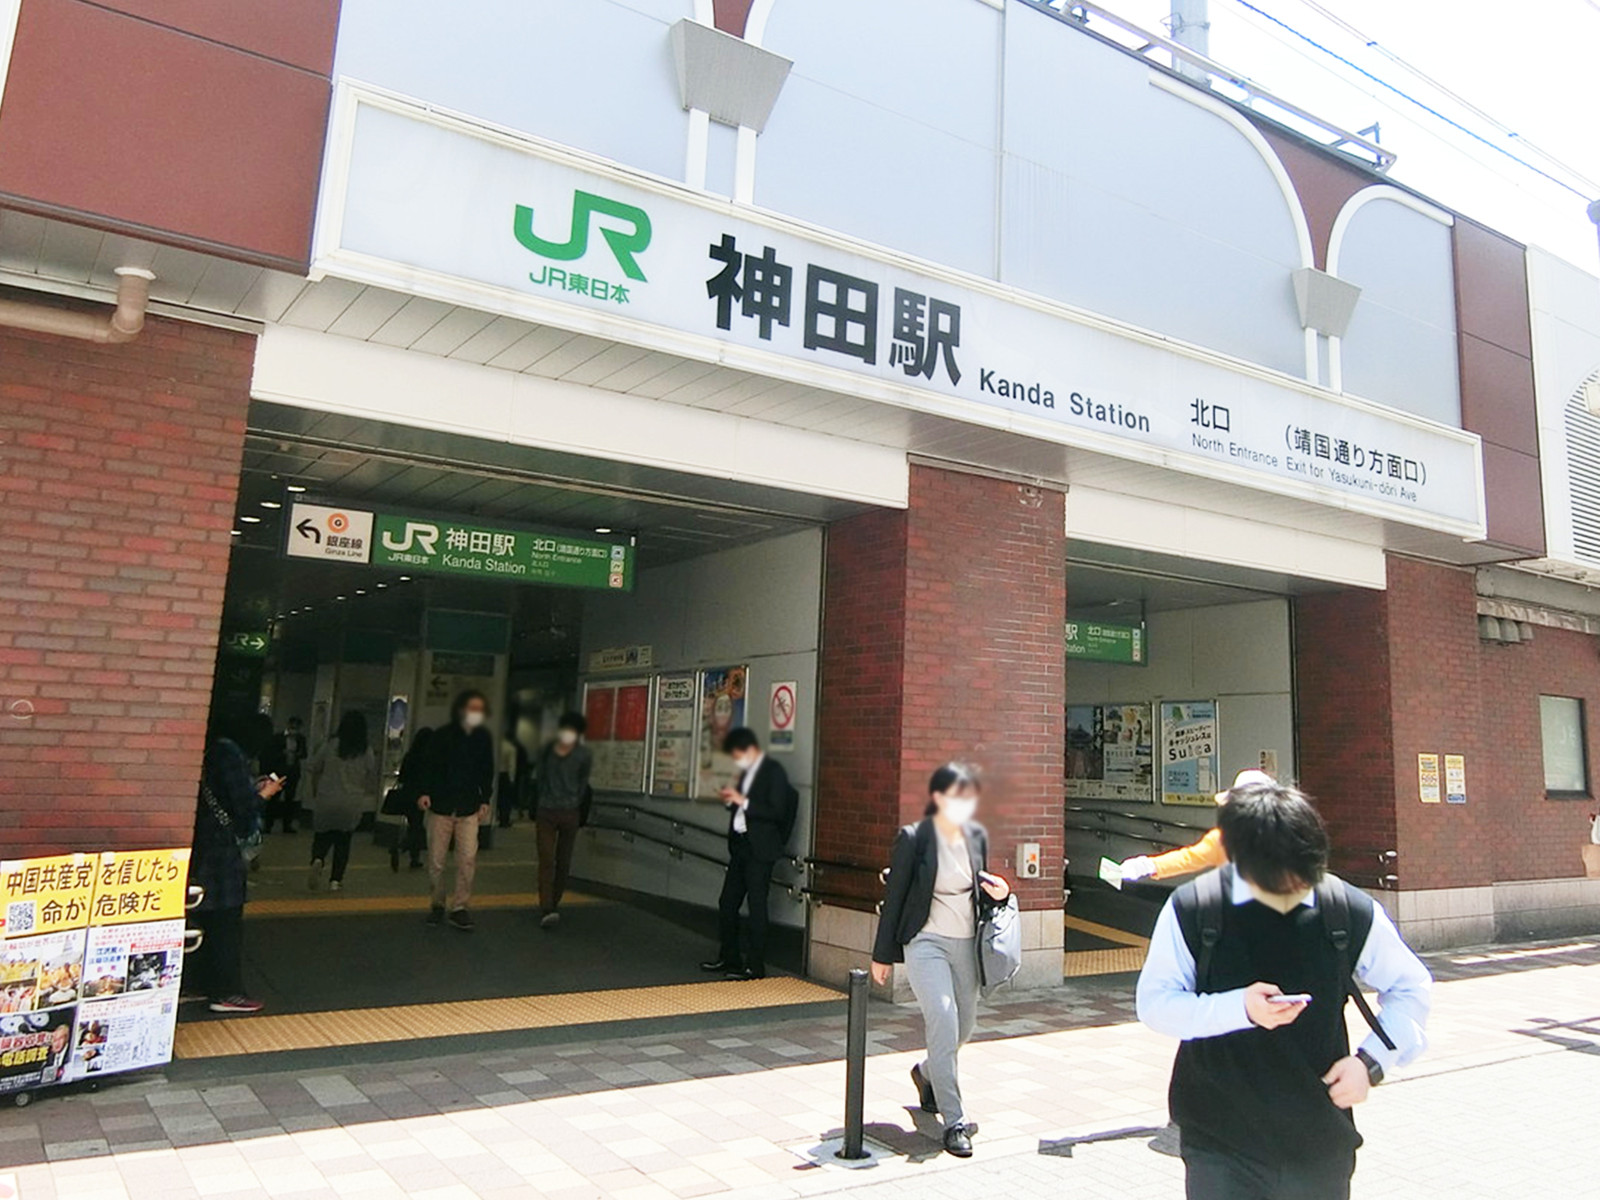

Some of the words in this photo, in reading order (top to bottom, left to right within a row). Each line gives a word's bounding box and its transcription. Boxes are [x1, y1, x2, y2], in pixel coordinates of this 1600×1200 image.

[513, 189, 652, 284] JR
[529, 265, 630, 304] JR東日本
[705, 232, 962, 387] 神田駅
[979, 367, 1055, 410] Kanda
[1069, 392, 1150, 433] Station
[1190, 398, 1230, 432] 北口
[1285, 424, 1427, 485] (靖国通り方面口)
[1192, 433, 1224, 453] North
[1229, 442, 1278, 467] Entrance
[1286, 456, 1307, 475] Exit
[1309, 463, 1324, 479] for
[1400, 487, 1417, 502] Ave
[325, 547, 346, 556] Ginza
[326, 535, 363, 549] 銀座線
[382, 522, 439, 555] JR
[445, 527, 515, 557] 神田駅
[442, 554, 481, 570] Kanda
[485, 558, 526, 574] Station
[1168, 743, 1212, 761] Suica
